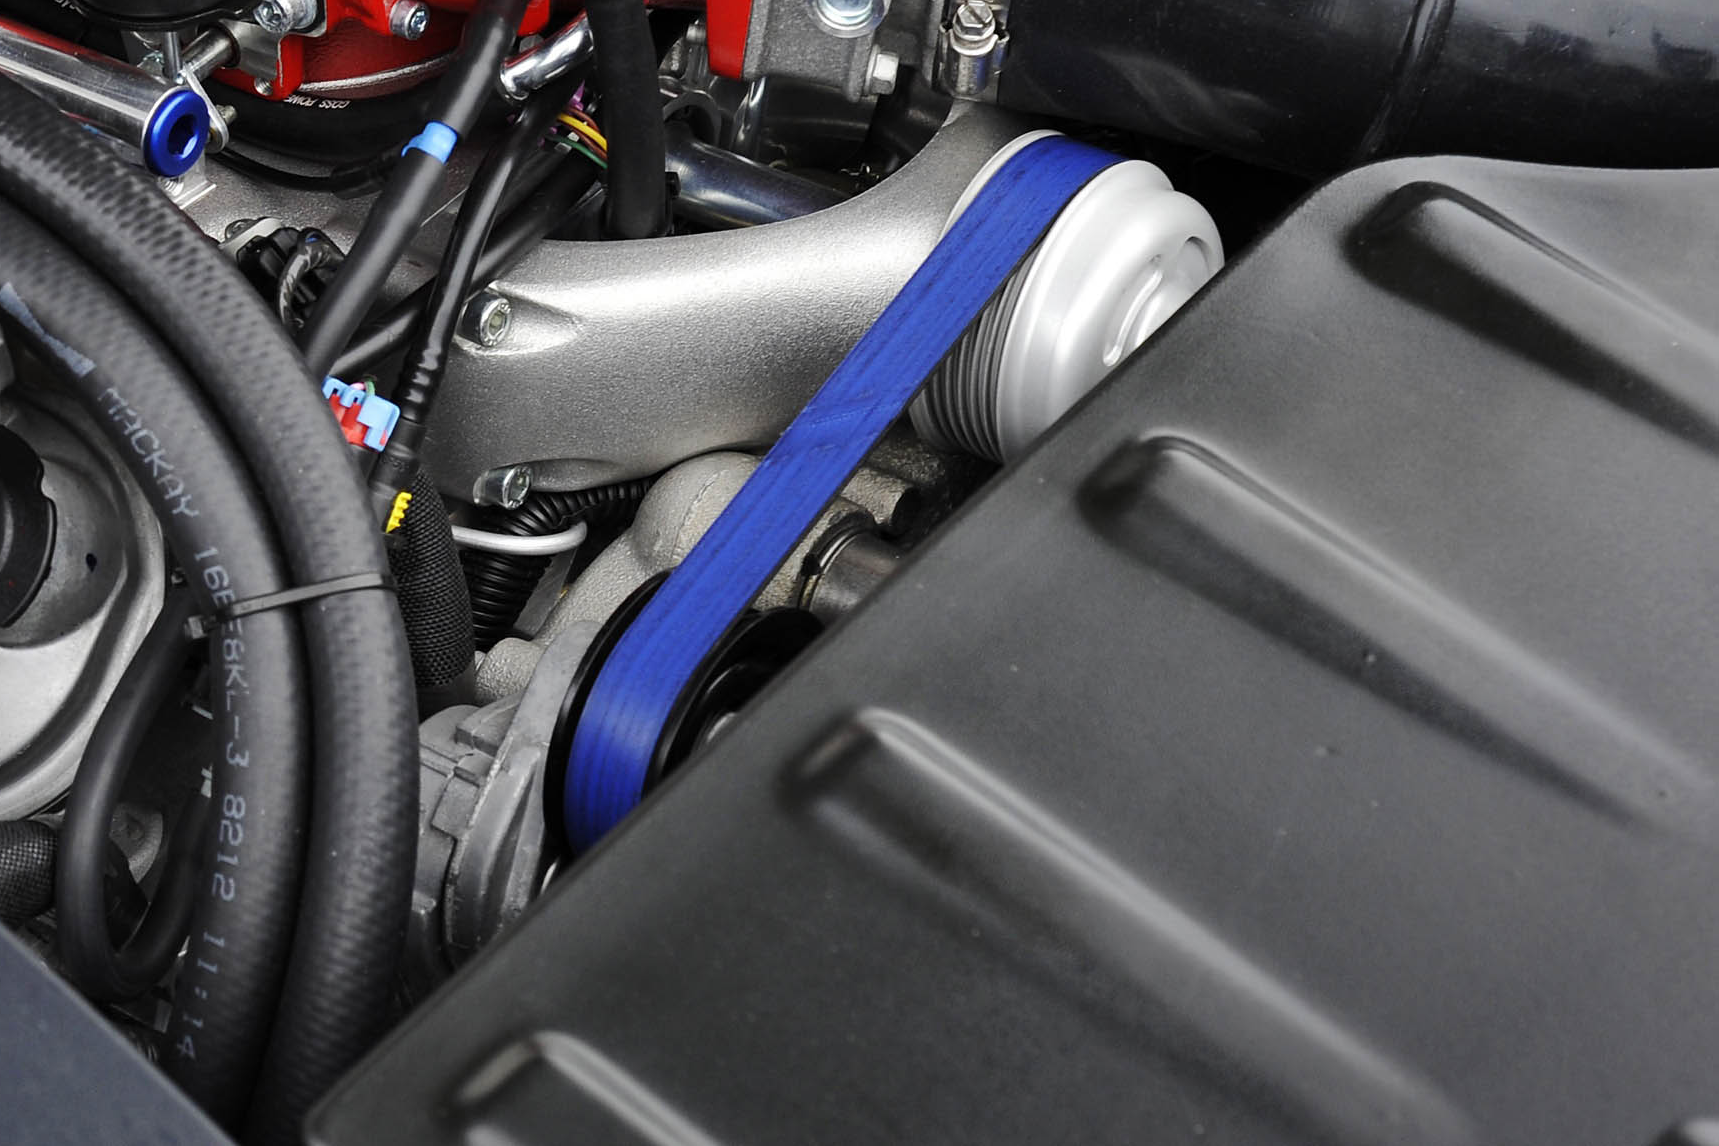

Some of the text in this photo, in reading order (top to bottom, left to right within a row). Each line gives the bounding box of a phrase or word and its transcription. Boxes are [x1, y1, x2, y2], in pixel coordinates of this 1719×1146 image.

[97, 387, 200, 517] MACKAY
[212, 794, 246, 902] 8212
[177, 931, 226, 1060] 11:14
